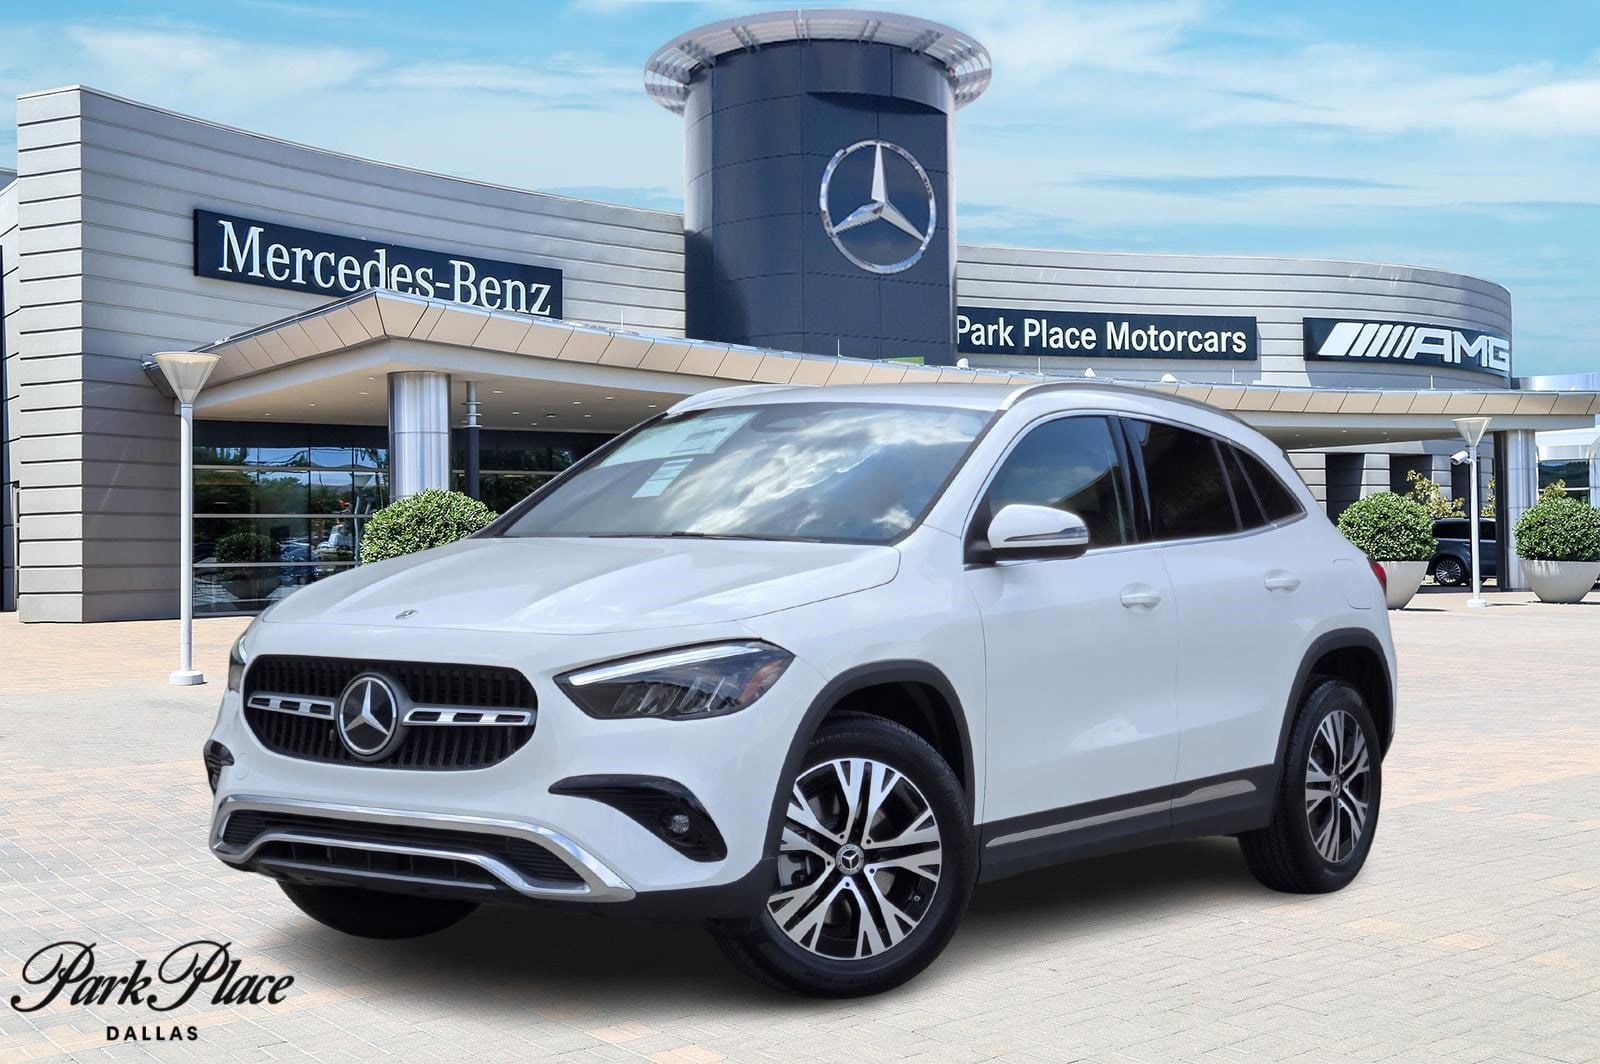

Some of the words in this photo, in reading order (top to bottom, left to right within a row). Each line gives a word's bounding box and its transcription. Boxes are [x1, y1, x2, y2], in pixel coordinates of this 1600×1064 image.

[217, 219, 553, 316] Mercedes-Benz
[957, 314, 1015, 347] Park
[1023, 318, 1097, 350] Place
[1106, 321, 1248, 353] Motorcars
